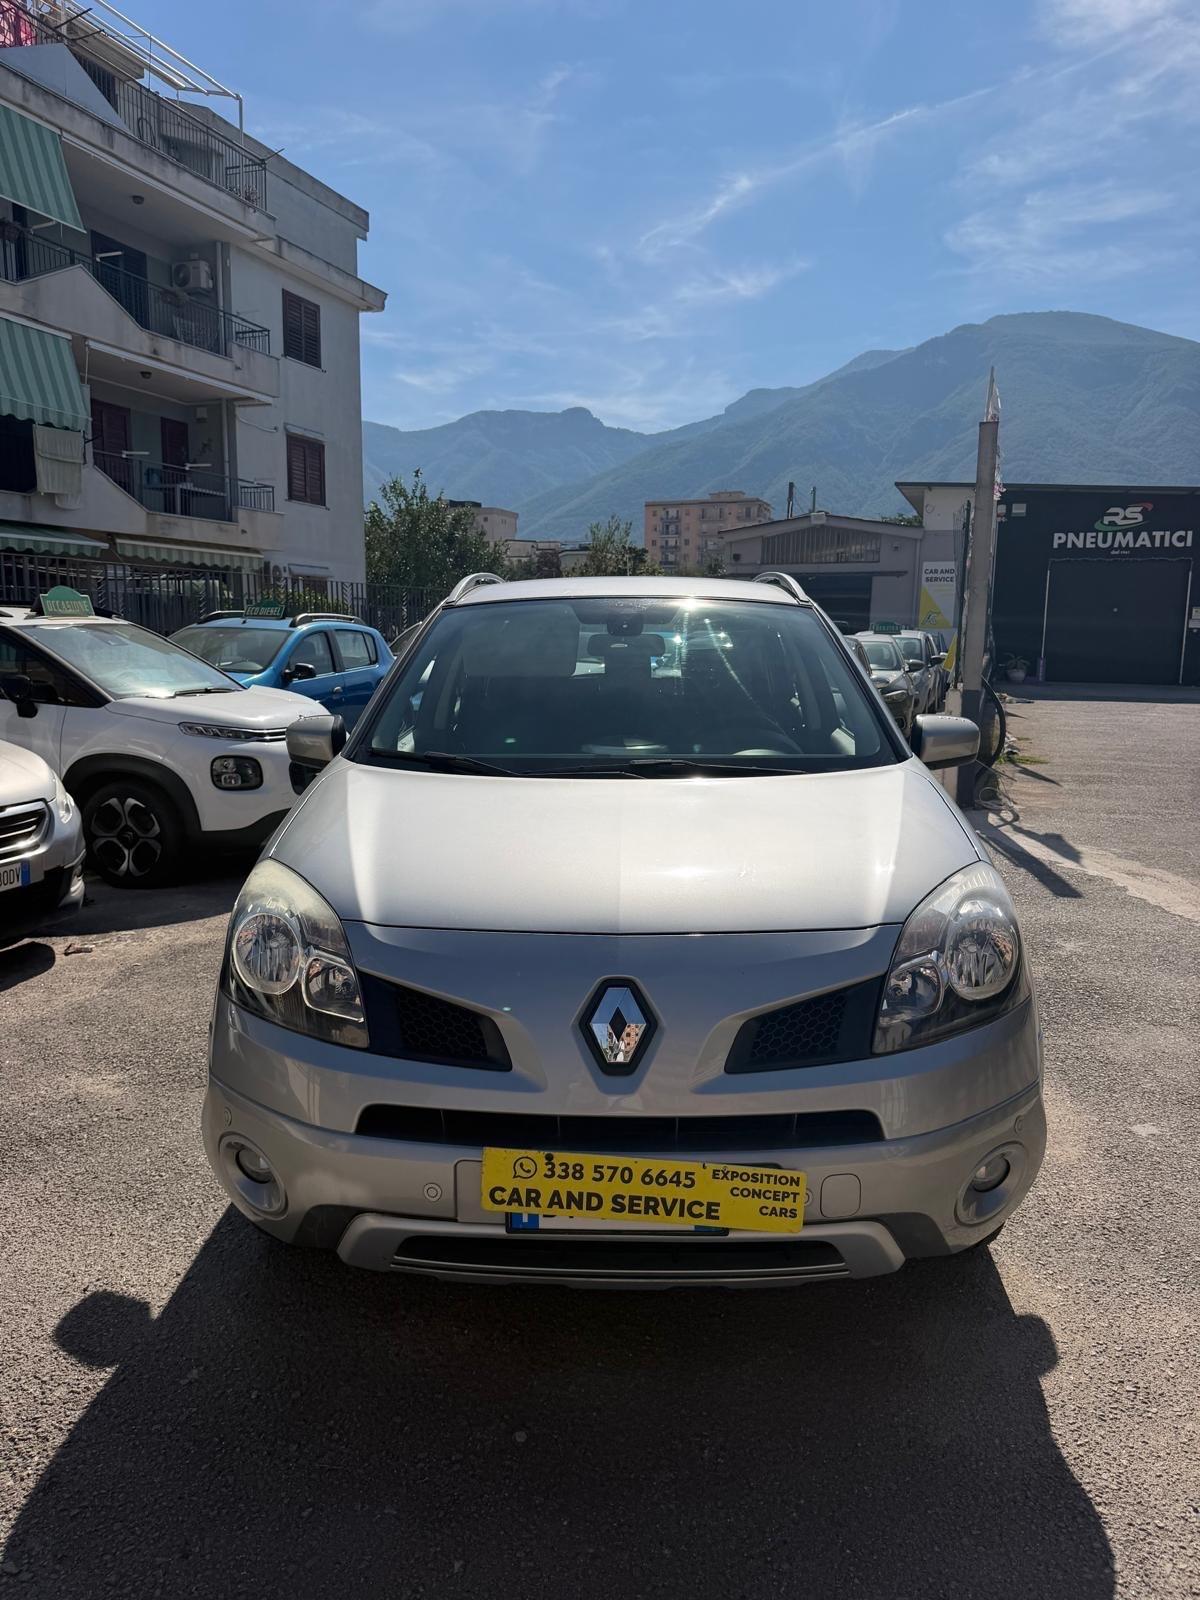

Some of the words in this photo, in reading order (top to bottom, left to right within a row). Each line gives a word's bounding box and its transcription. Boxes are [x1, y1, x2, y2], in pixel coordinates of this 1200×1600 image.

[1103, 506, 1143, 525] RS
[1053, 530, 1193, 549] PNEUMATICI
[246, 606, 260, 616] ECO
[260, 606, 283, 616] DIESEL
[543, 1160, 584, 1181] 338
[591, 1164, 633, 1184] 570
[640, 1168, 696, 1189] 6645
[711, 1168, 801, 1187] EXPOSITION
[489, 1186, 542, 1209] CAR
[546, 1189, 604, 1212] AND
[610, 1193, 721, 1221] SERVICE
[730, 1187, 800, 1203] CONCEPT
[759, 1205, 798, 1219] CARS
